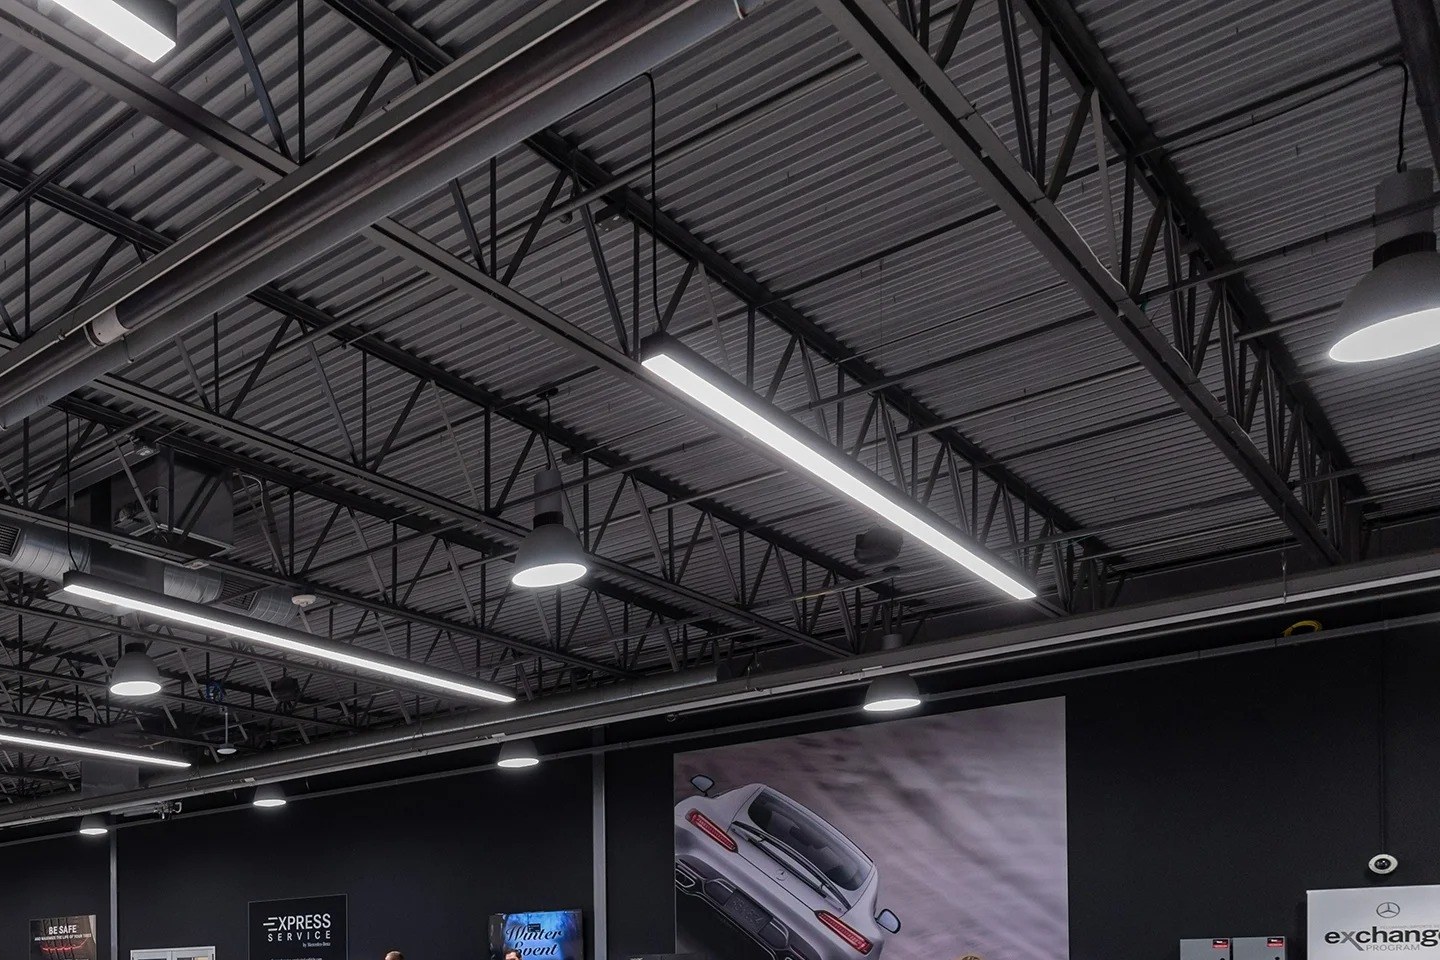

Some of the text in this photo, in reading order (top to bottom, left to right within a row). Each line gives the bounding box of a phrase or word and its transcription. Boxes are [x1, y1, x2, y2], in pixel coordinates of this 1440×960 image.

[48, 925, 77, 934] BE SAFE
[263, 914, 331, 932] EXPRESS
[268, 930, 331, 942] SERVICE
[506, 926, 562, 941] Winter
[1324, 926, 1440, 951] exchang
[514, 942, 558, 956] Event
